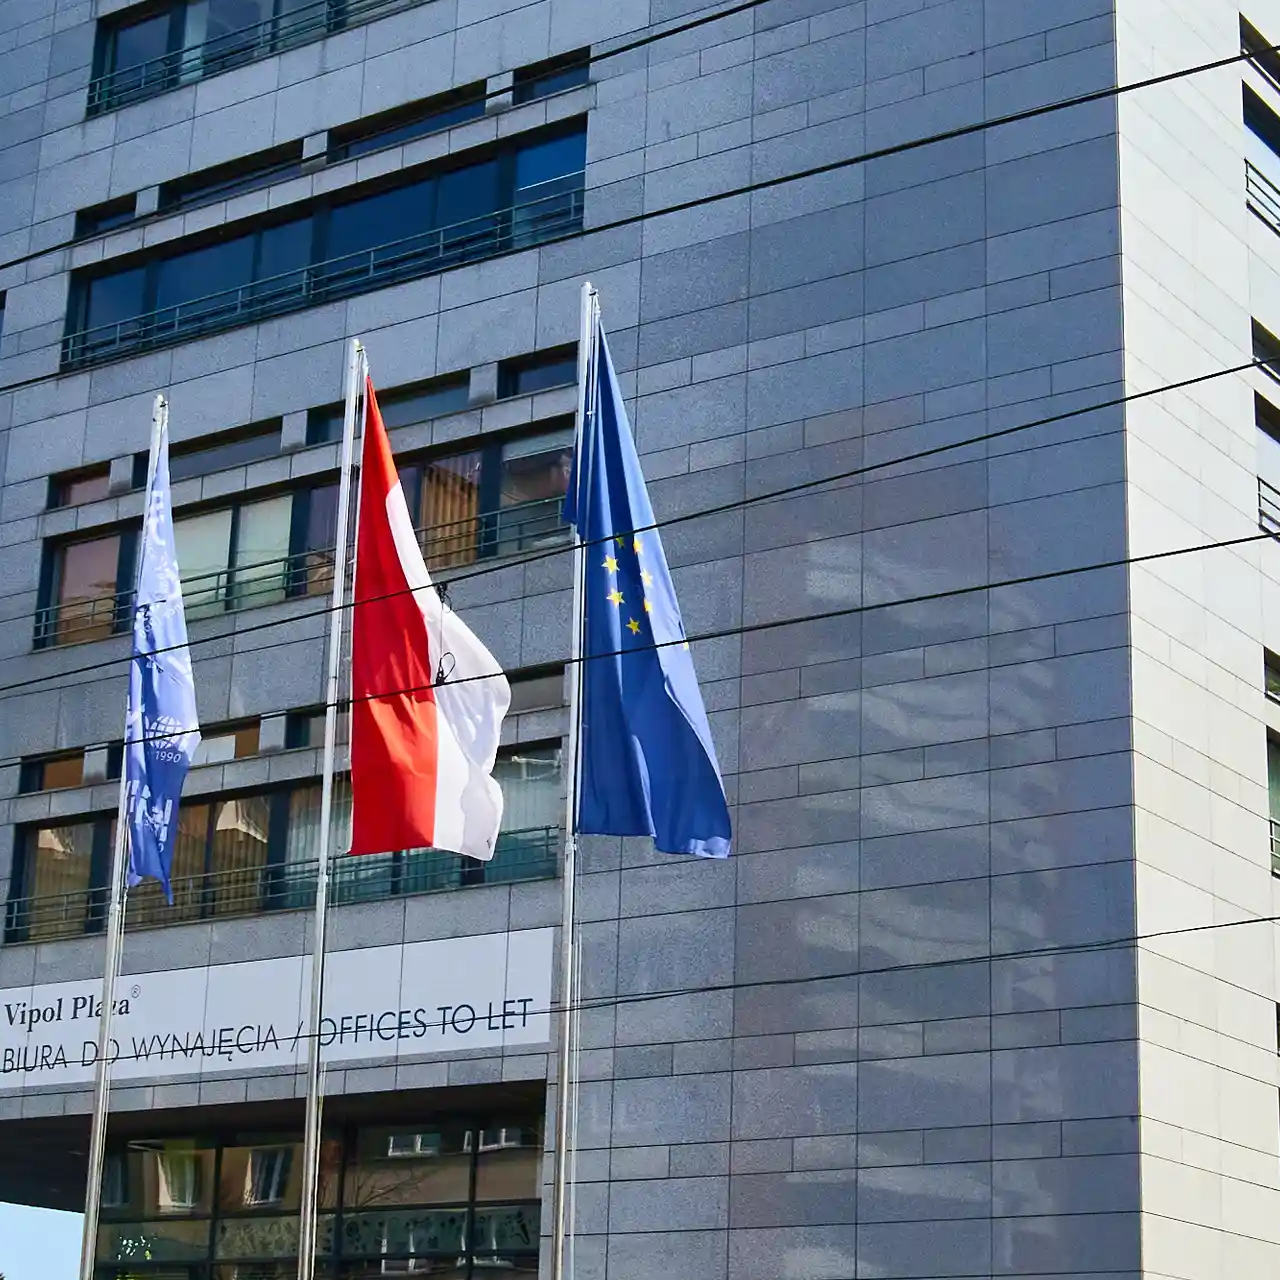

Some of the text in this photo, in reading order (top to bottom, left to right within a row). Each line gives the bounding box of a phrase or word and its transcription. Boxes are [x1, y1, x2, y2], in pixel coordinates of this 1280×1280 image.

[3, 1043, 68, 1074] BIURA
[131, 1023, 280, 1062] WYNAJĘCIA
[290, 1020, 304, 1053] /
[319, 1008, 427, 1047] OFFICES
[436, 1003, 476, 1035] TO
[487, 997, 534, 1031] LET
[4, 997, 63, 1033] Vipol
